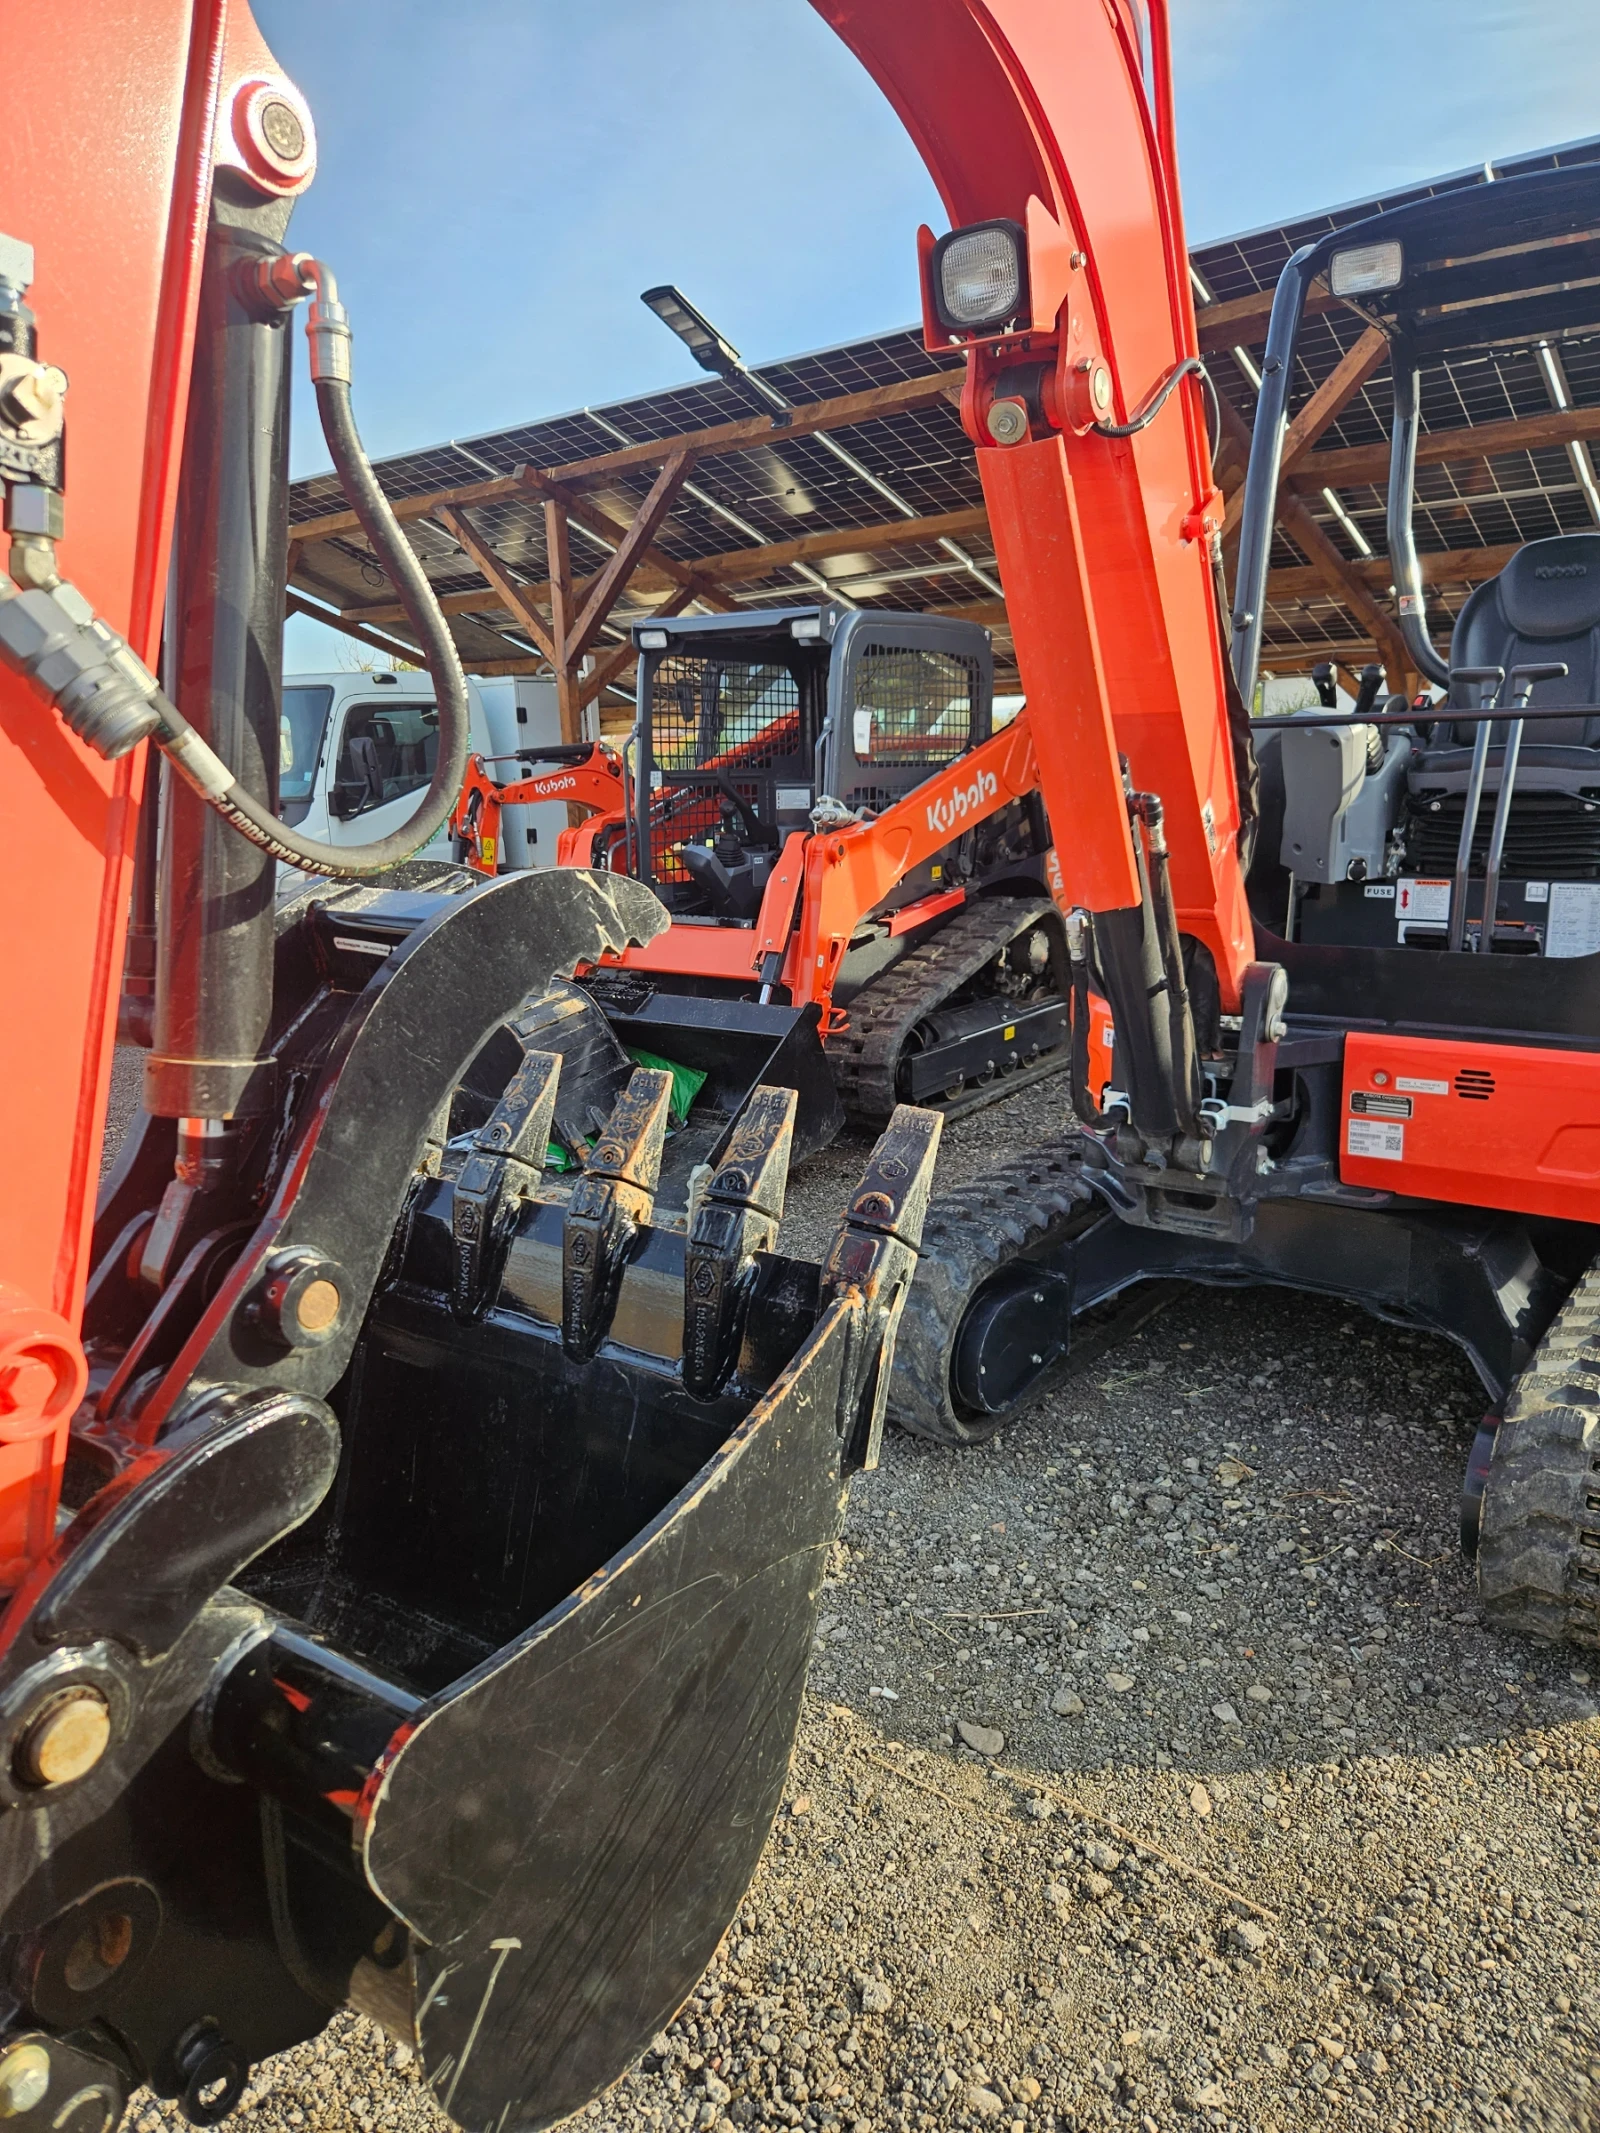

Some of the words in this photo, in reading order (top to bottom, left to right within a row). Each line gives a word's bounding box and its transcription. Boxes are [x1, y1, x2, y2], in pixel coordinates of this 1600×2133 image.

[534, 776, 576, 795] Kubota
[211, 792, 236, 814] PS
[926, 769, 998, 833] Kubota
[268, 841, 301, 864] BAR
[1366, 888, 1392, 896] FUSE
